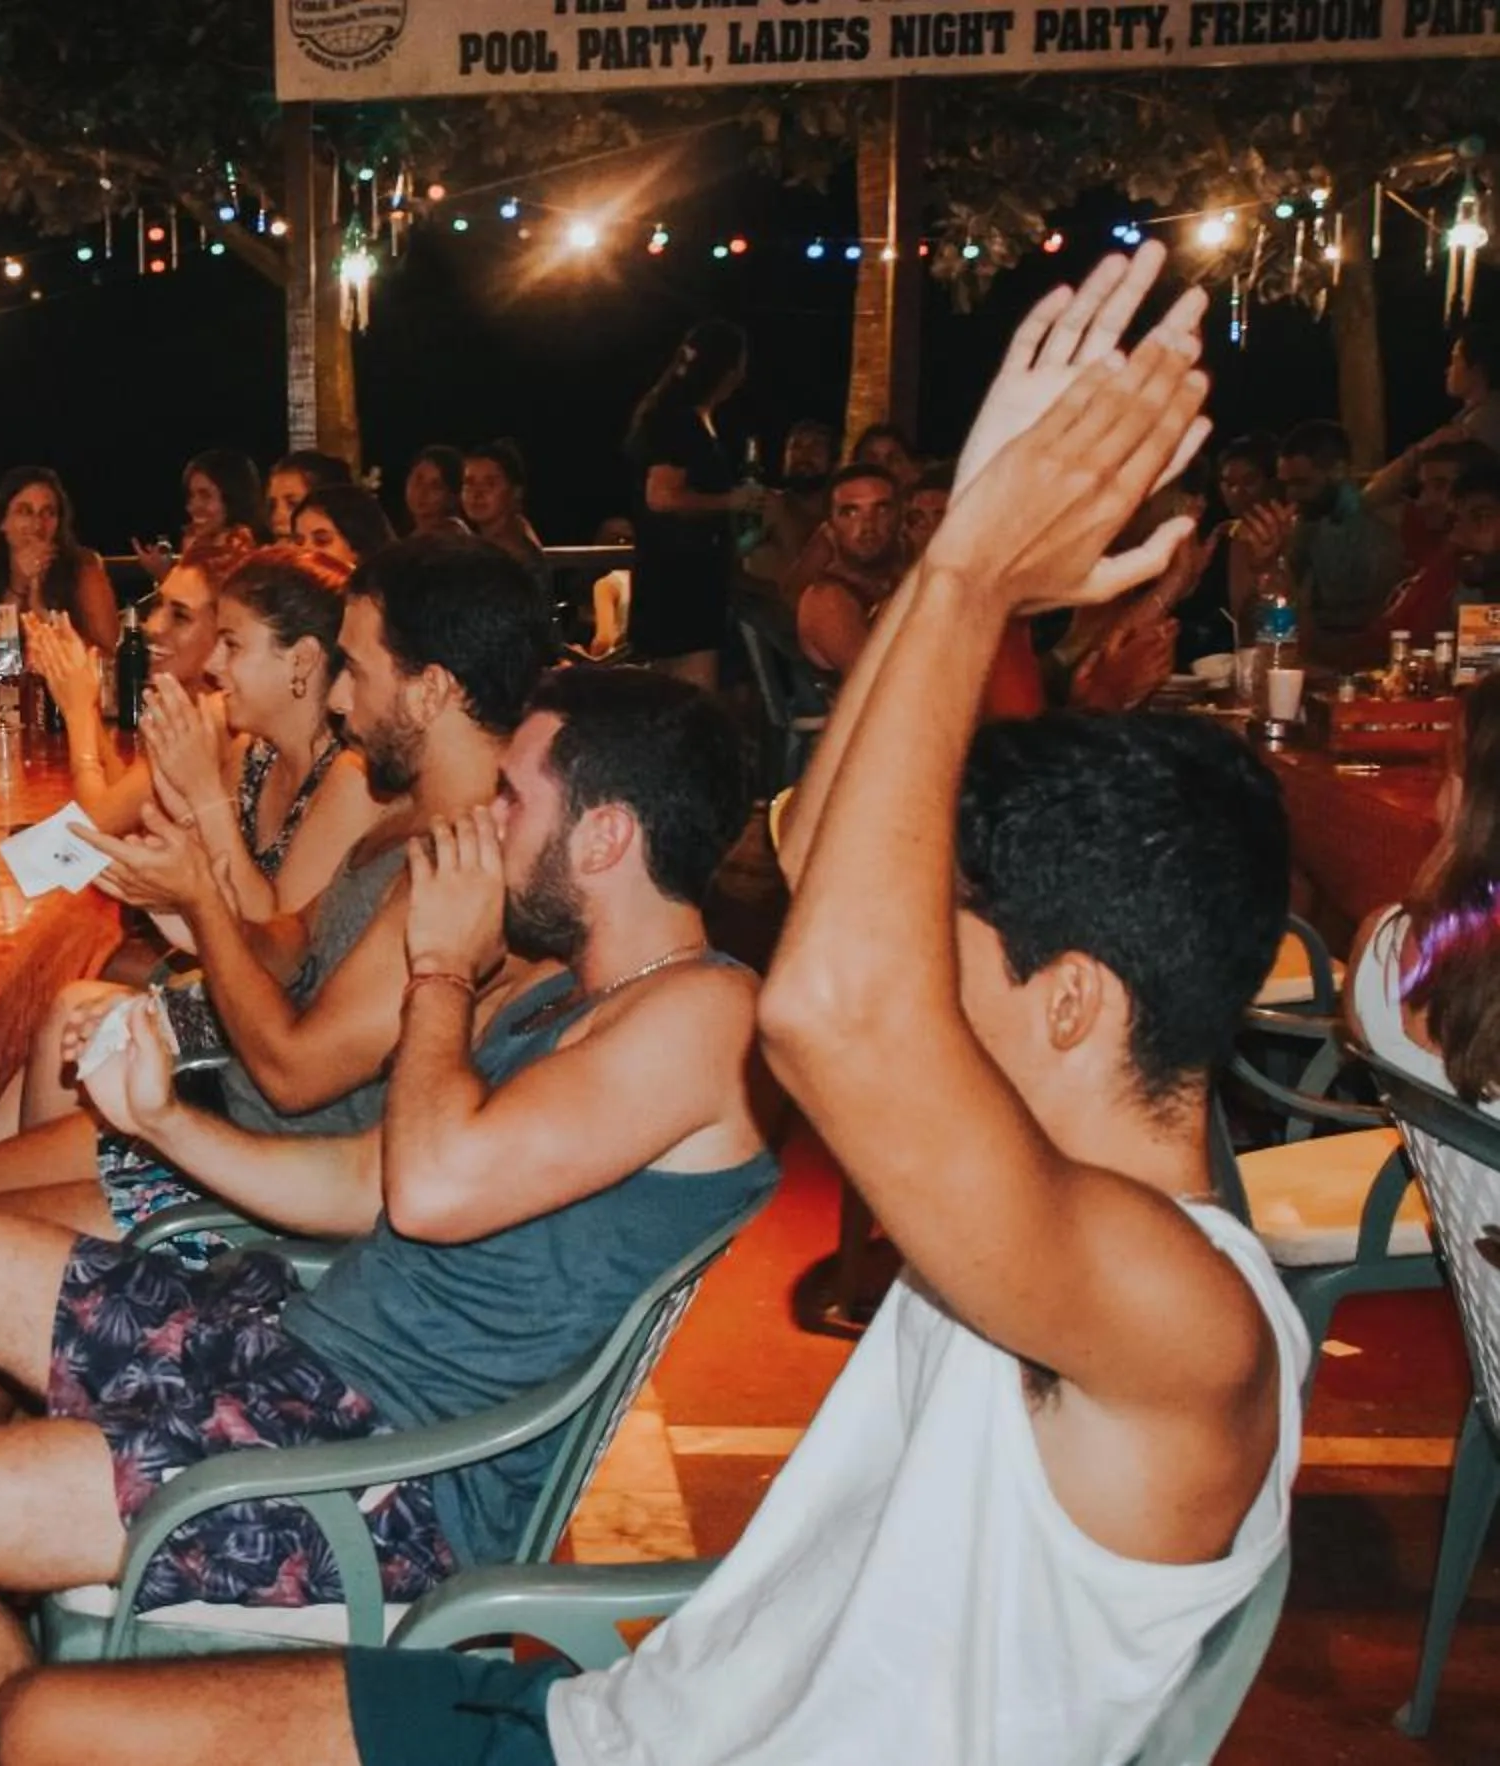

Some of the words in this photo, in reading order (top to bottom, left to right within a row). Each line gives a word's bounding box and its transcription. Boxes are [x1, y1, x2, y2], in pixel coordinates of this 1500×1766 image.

[459, 30, 557, 75] POOL
[577, 23, 713, 72] PARTY,
[727, 17, 870, 65] LADIES
[889, 11, 1014, 57] NIGHT
[1033, 2, 1174, 55] PARTY,
[1189, 0, 1382, 46] FREEDOM
